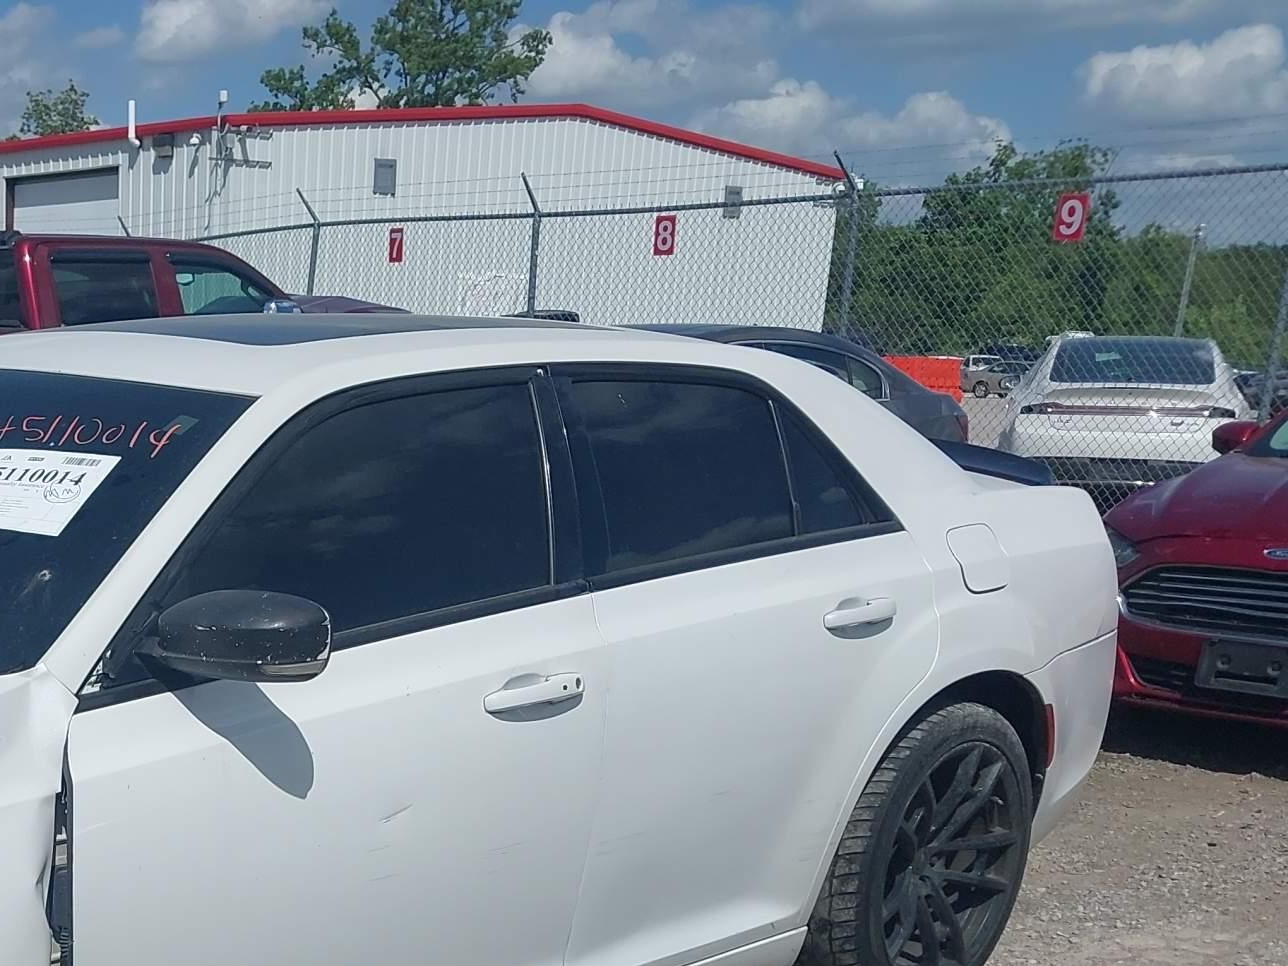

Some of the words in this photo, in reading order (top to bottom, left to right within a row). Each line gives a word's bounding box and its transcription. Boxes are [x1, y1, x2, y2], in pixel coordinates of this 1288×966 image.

[1059, 199, 1083, 235] 9
[391, 232, 402, 259] 7
[656, 220, 673, 251] 8
